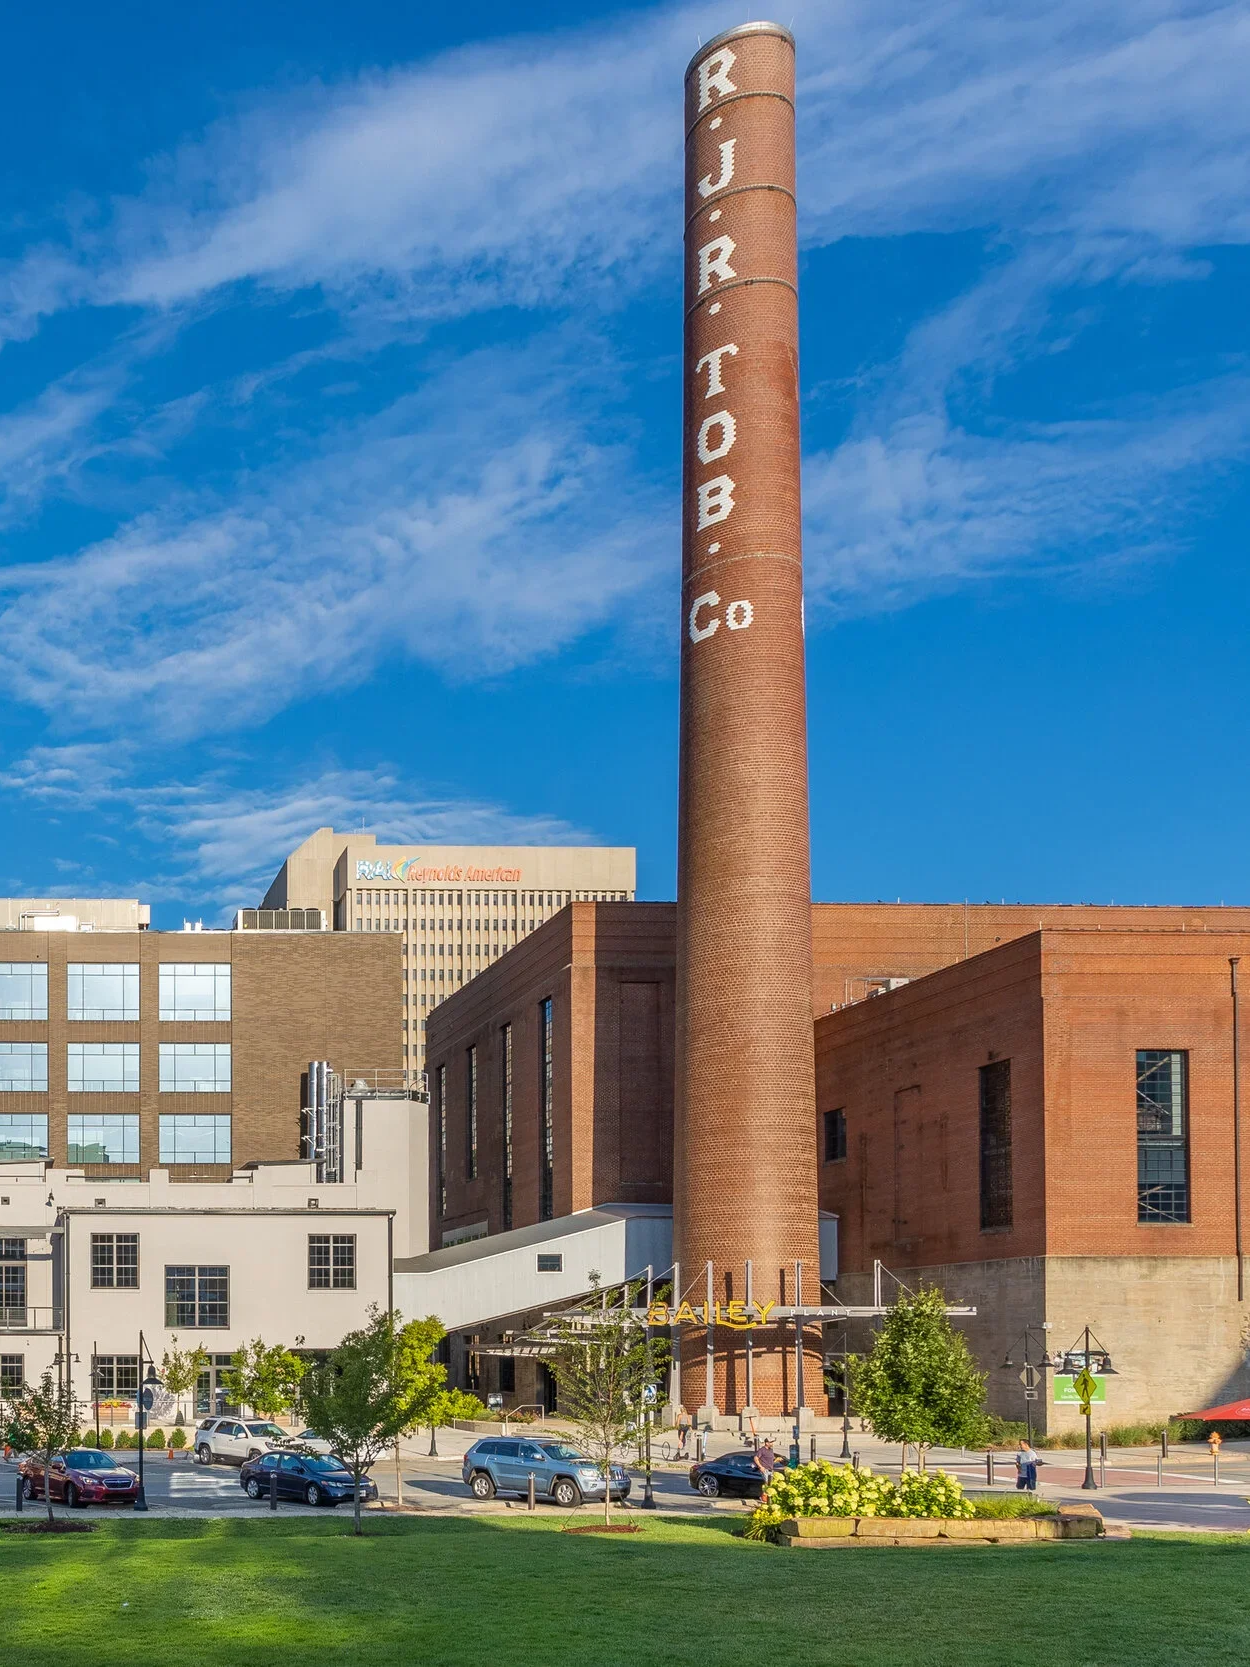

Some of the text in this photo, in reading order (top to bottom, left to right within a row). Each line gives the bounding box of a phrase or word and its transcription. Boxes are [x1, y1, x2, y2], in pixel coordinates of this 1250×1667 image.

[406, 865, 463, 884] Reynolds
[464, 866, 522, 882] American
[647, 1300, 775, 1330] BAILEY
[790, 1308, 852, 1317] PLANT
